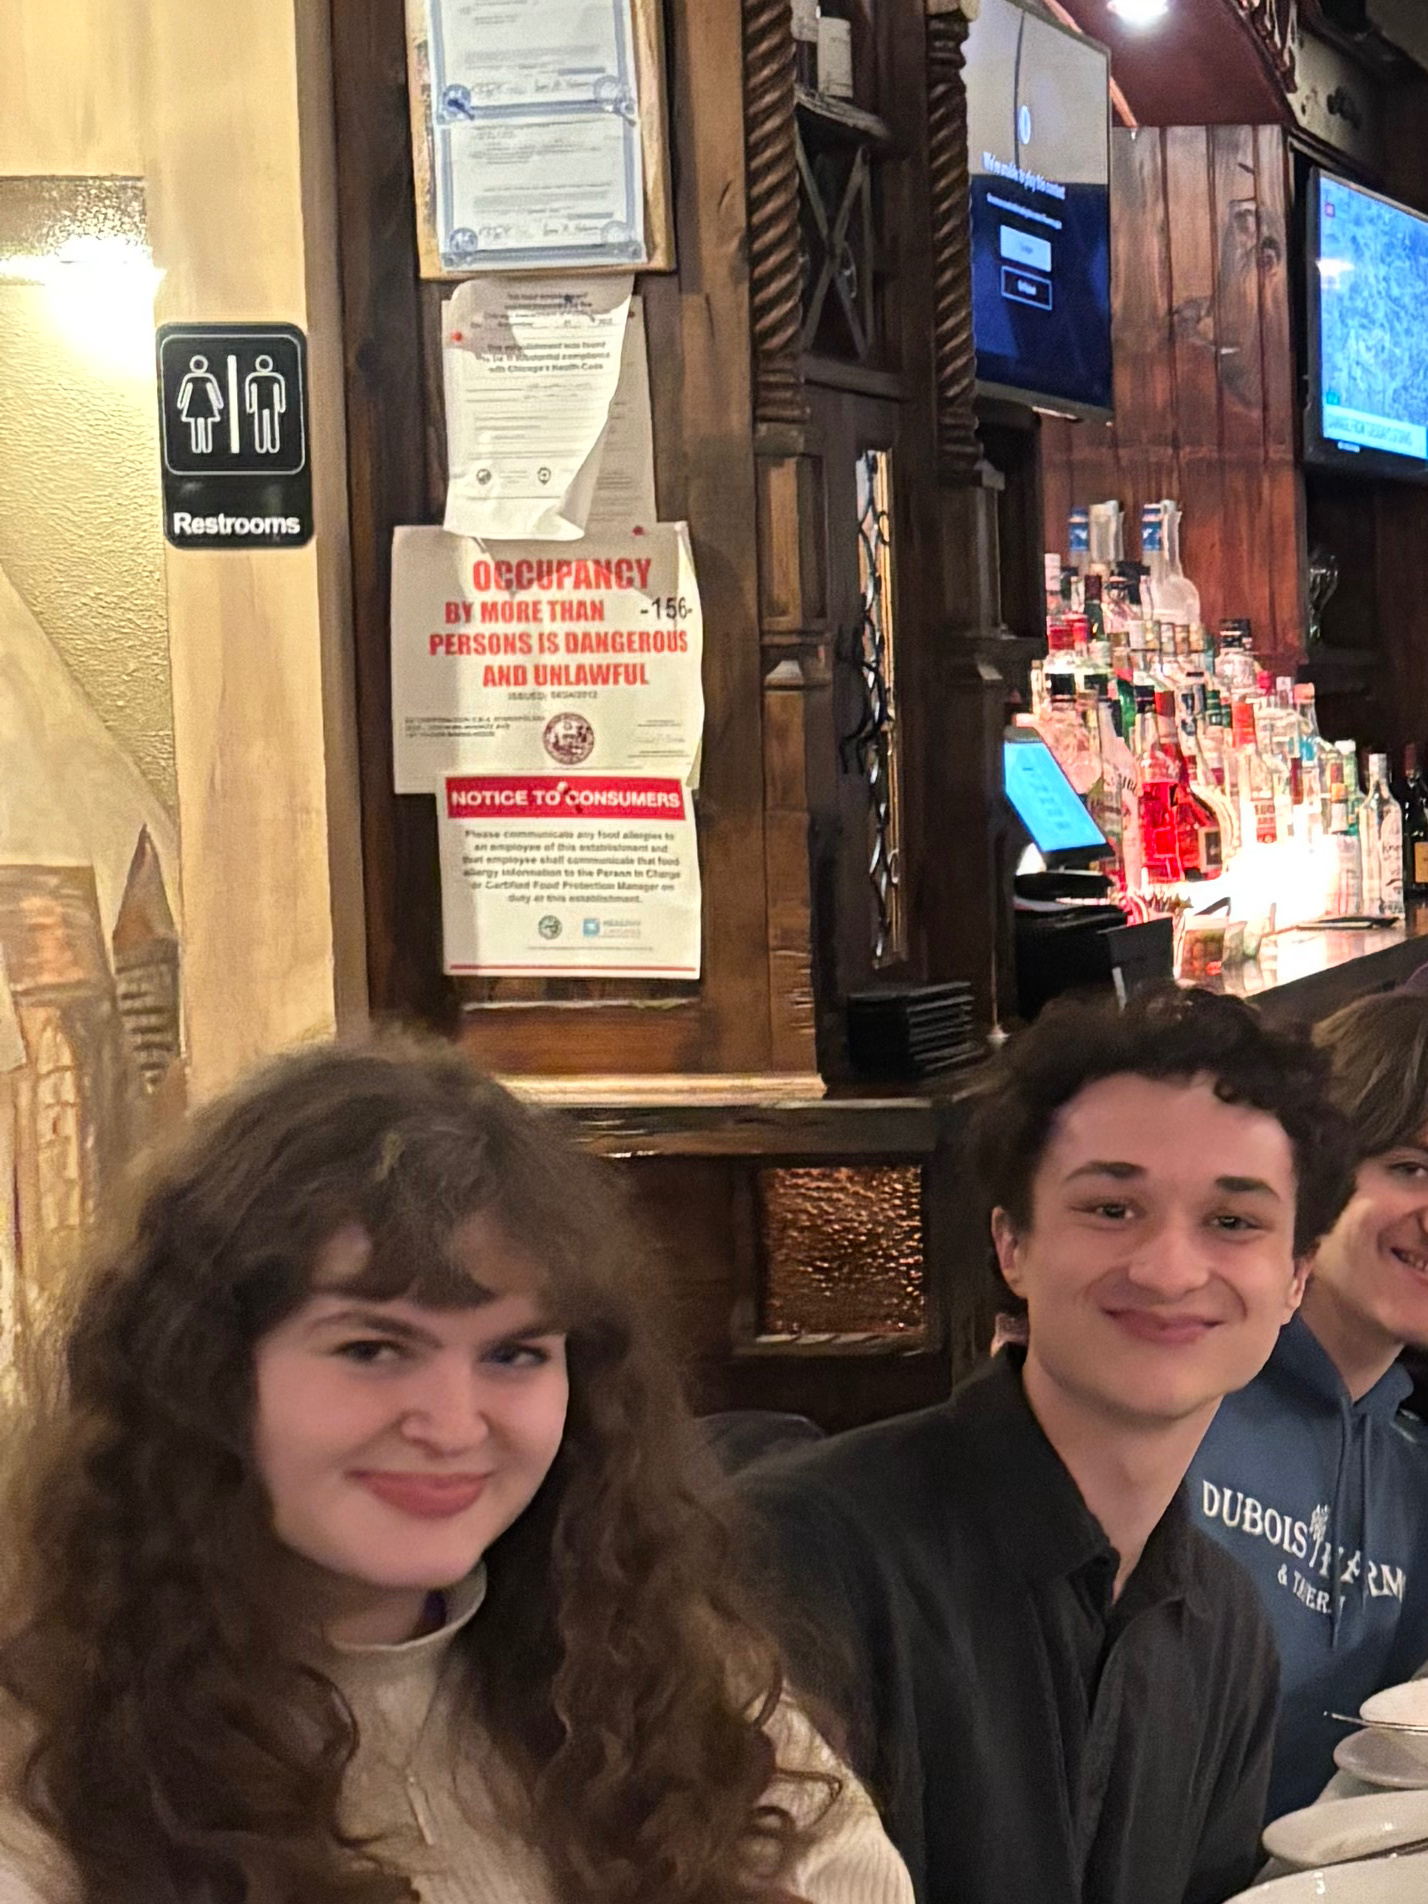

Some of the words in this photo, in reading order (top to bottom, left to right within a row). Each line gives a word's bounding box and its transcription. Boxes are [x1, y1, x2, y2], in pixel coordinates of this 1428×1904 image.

[173, 511, 301, 536] Restrooms
[472, 557, 652, 592] OCCUPANCY
[445, 600, 473, 625] BY
[480, 600, 543, 624] MORE
[549, 599, 605, 623] THAN
[429, 632, 533, 656] PERSONS
[538, 632, 560, 655] IS
[565, 630, 689, 655] DANGEROUS
[483, 664, 528, 688] AND
[534, 662, 650, 687] UNLAWFUL
[451, 790, 528, 807] NOTICE
[532, 789, 562, 807] TO
[565, 789, 681, 809] CONSUMERS
[1202, 1479, 1309, 1560] DUBOIS
[1277, 1562, 1288, 1587] &
